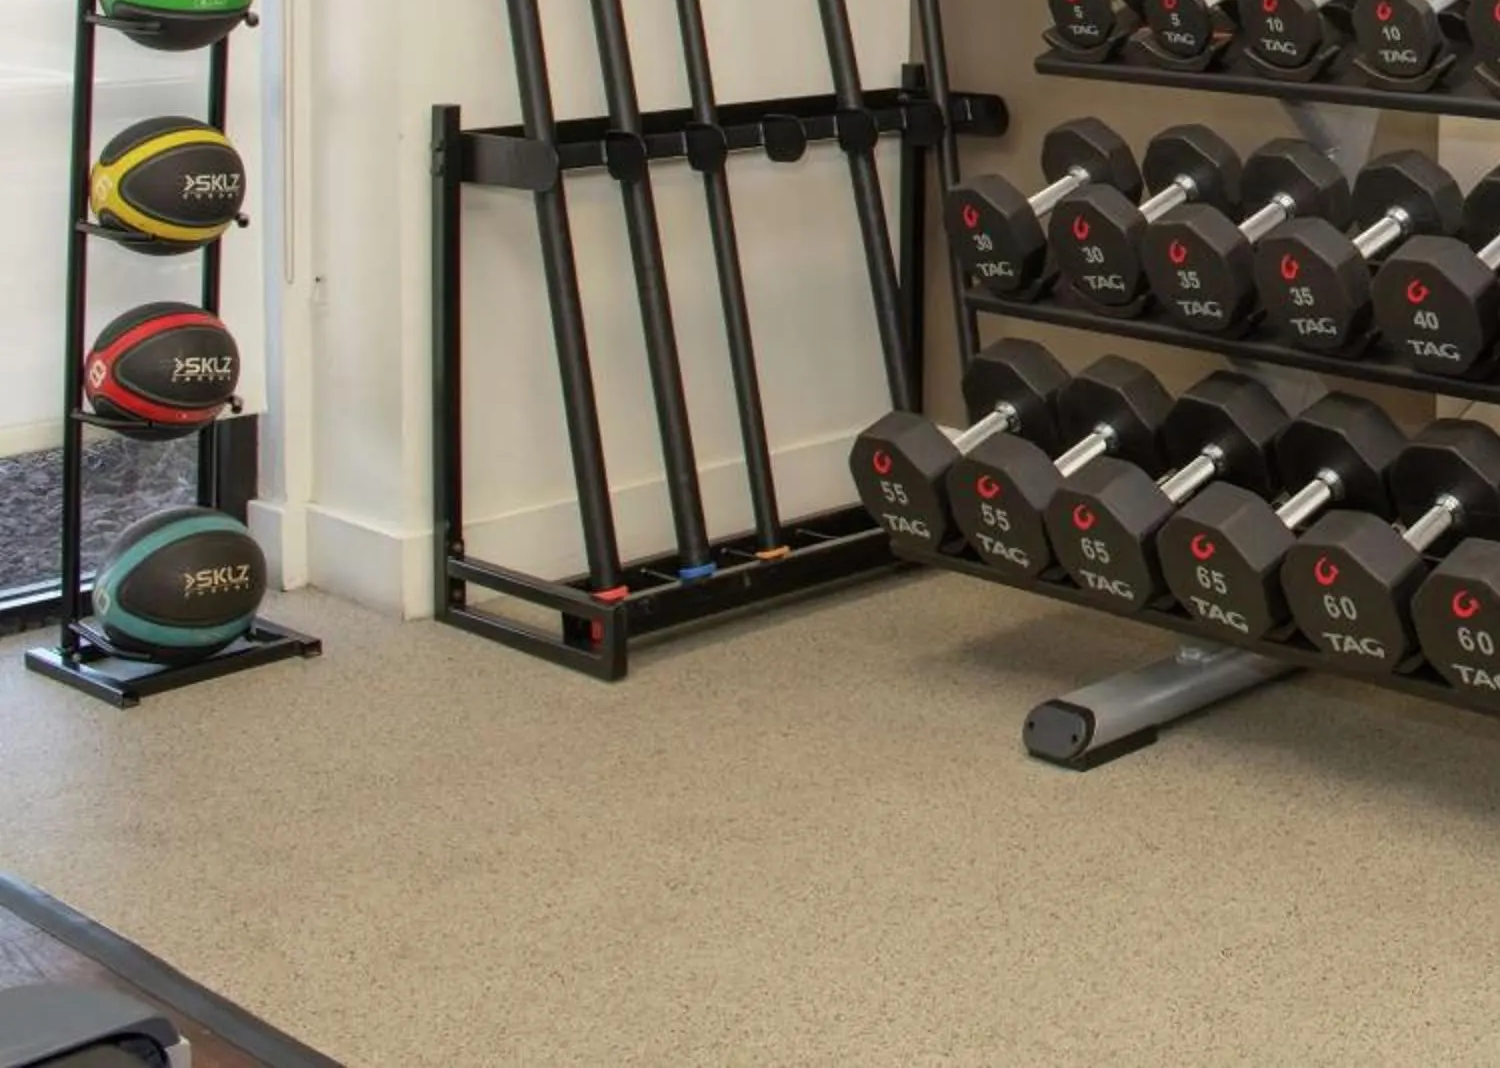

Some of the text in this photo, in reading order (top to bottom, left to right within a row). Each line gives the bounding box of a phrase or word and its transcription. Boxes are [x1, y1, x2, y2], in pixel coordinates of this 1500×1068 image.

[1073, 5, 1083, 20] 5
[1171, 13, 1180, 27] 5
[1068, 24, 1098, 36] TAG
[1265, 17, 1284, 33] 10
[1381, 25, 1401, 41] 10
[1165, 32, 1194, 46] TAG
[1261, 38, 1297, 56] TAG
[1379, 49, 1417, 64] TAG
[195, 173, 241, 192] SKLZ
[972, 234, 993, 252] 30
[1082, 246, 1105, 264] 30
[976, 262, 1014, 277] TAG
[1083, 275, 1125, 292] TAG
[1178, 270, 1200, 289] 35
[1290, 287, 1315, 307] 35
[1177, 300, 1223, 318] TAG
[1290, 318, 1337, 336] TAG
[1413, 310, 1440, 329] 40
[1406, 339, 1461, 362] TAG
[184, 356, 233, 374] SKLZ
[881, 479, 909, 506] 55
[882, 512, 930, 540] TAG
[981, 503, 1011, 532] 55
[976, 532, 1029, 568] TAG
[1081, 536, 1110, 565] 65
[195, 564, 250, 587] SKLZ
[1196, 566, 1228, 596] 65
[1079, 570, 1134, 601] TAG
[1190, 596, 1249, 633] TAG
[1323, 594, 1357, 621] 60
[1322, 632, 1385, 659] TAG
[1456, 627, 1495, 657] 60
